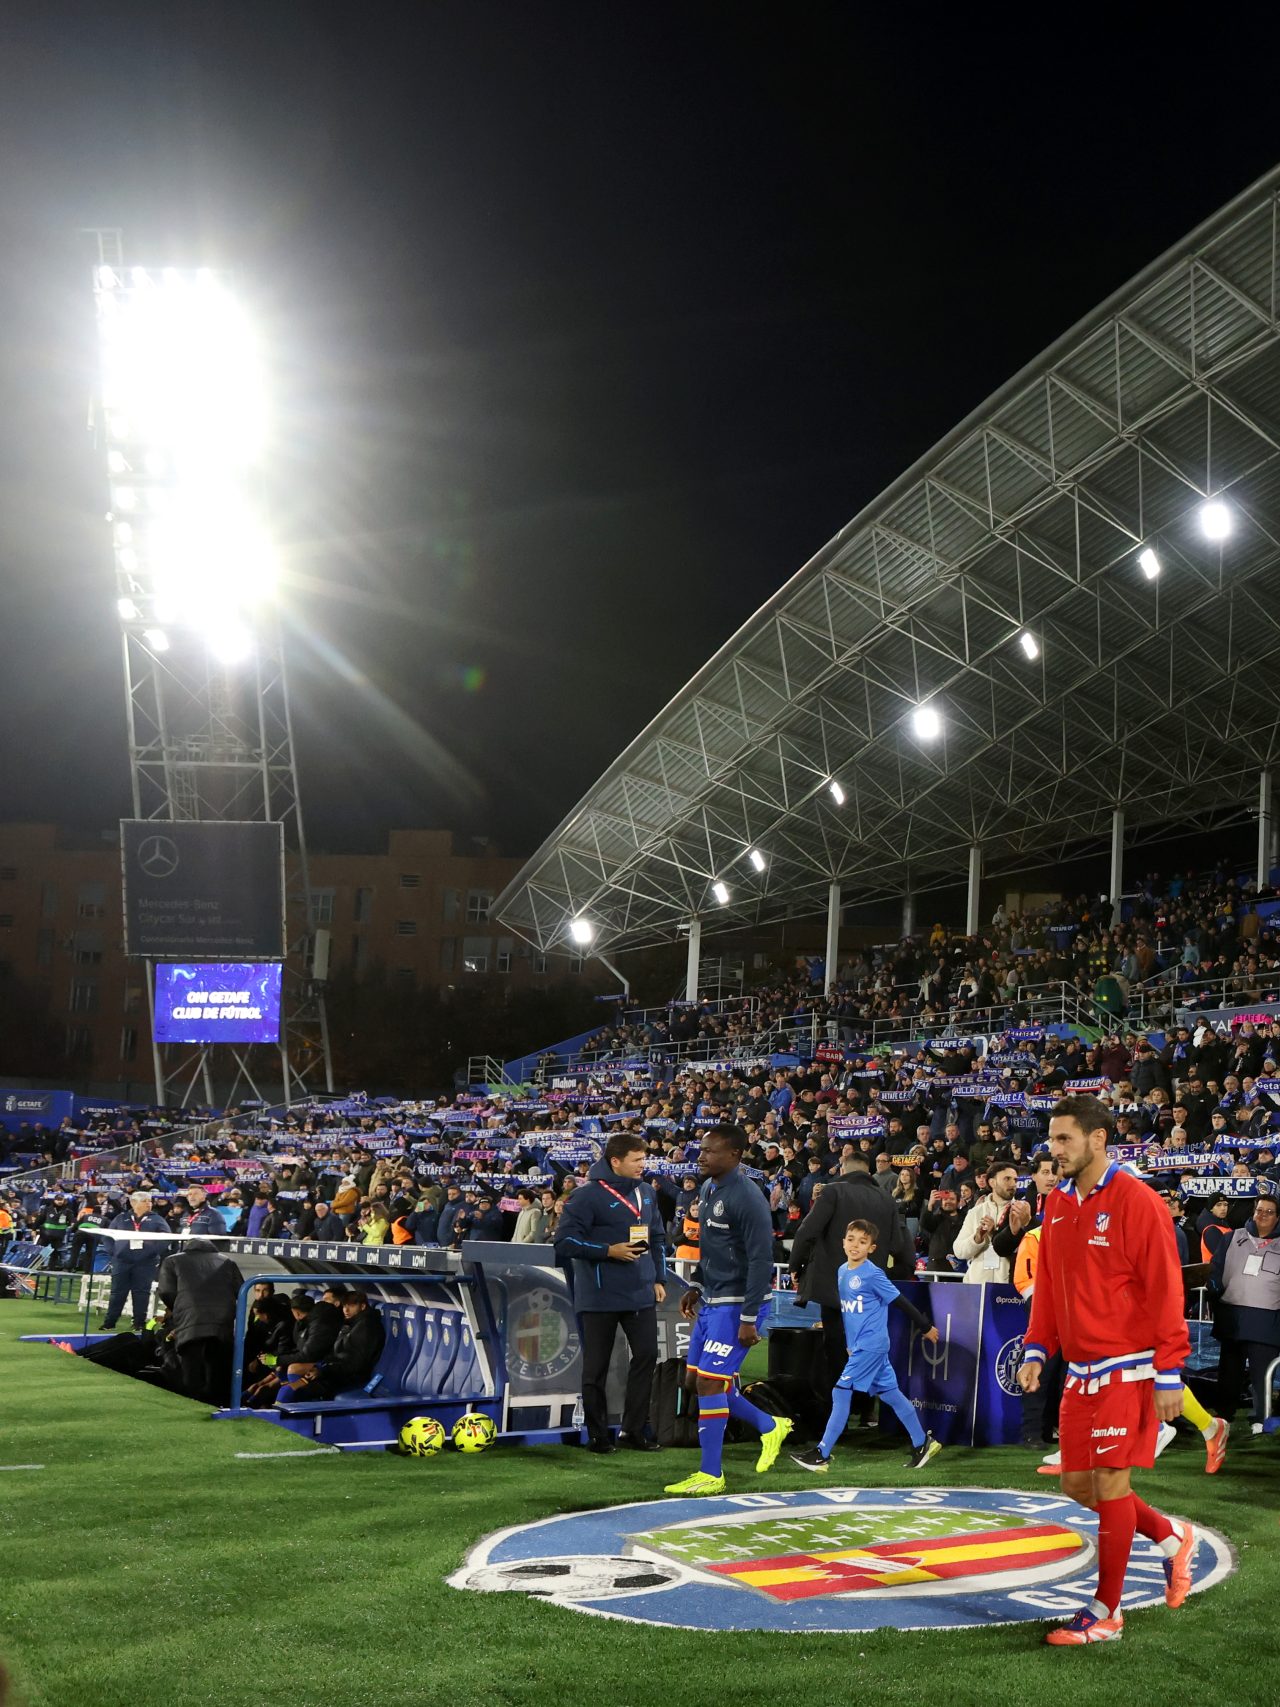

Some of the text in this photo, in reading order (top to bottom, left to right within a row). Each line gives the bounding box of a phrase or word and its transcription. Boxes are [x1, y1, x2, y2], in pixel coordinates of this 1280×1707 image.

[209, 991, 251, 1004] GETAFE
[172, 1007, 202, 1019] CLUB
[203, 1007, 220, 1019] DE
[931, 1039, 968, 1048] GETAFE CF
[826, 1052, 839, 1060] BAR
[933, 1076, 974, 1086] GETAFE
[17, 1101, 43, 1109] GETAFE
[1032, 1100, 1056, 1109] GETA
[839, 1128, 869, 1137] GETAFE
[458, 1151, 483, 1159] GETAFE
[418, 1165, 443, 1175] GETAFE
[1236, 1178, 1255, 1192] CF
